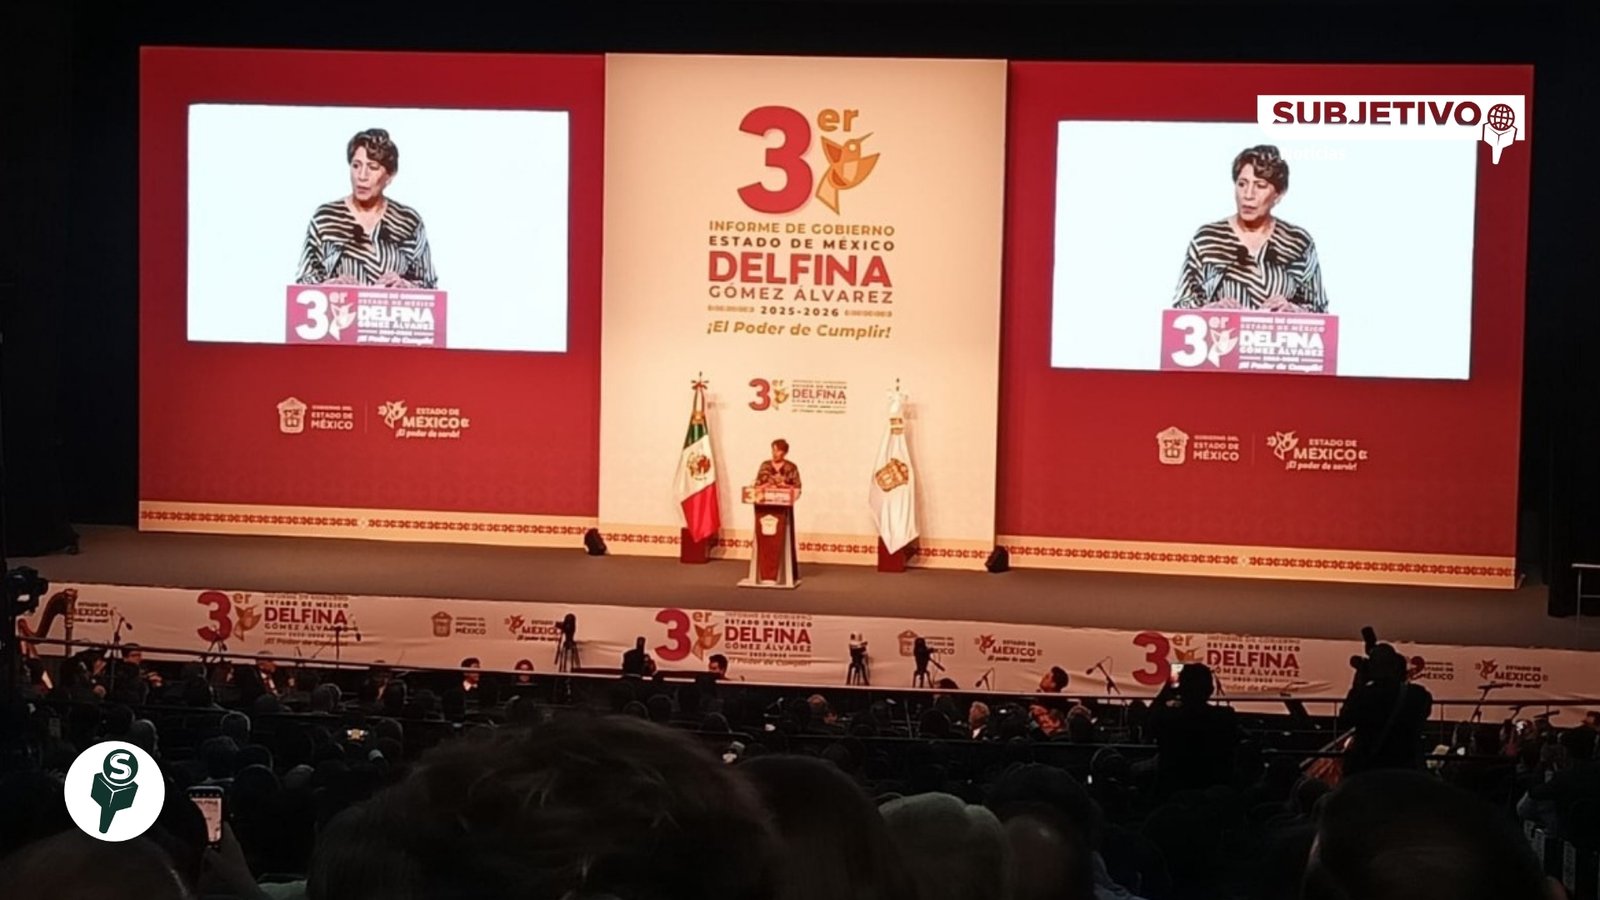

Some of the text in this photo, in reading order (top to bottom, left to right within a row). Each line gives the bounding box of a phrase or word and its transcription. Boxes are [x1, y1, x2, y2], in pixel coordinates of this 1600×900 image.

[709, 220, 895, 237] INFORME DE GOBIERNO
[709, 235, 895, 251] ESTADO DE MÉXICO
[708, 250, 893, 288] DELFINA
[708, 282, 894, 304] GÓMEZ ÁLVAREZ
[357, 304, 435, 323] DELFINA
[760, 305, 840, 317] 2025-2026
[707, 319, 892, 340] ¡El Poder de Cumplir!
[1239, 330, 1324, 349] DELFINA
[792, 388, 847, 401] DELFINA
[416, 407, 460, 416] ESTADO DE
[1193, 442, 1226, 450] ESTADO
[1308, 438, 1358, 448] ESTADO DE
[264, 606, 348, 625] DELFINA
[725, 626, 811, 645] DELFINA
[1207, 649, 1300, 669] DELFINA
[1213, 665, 1246, 675] ÓMEZ
